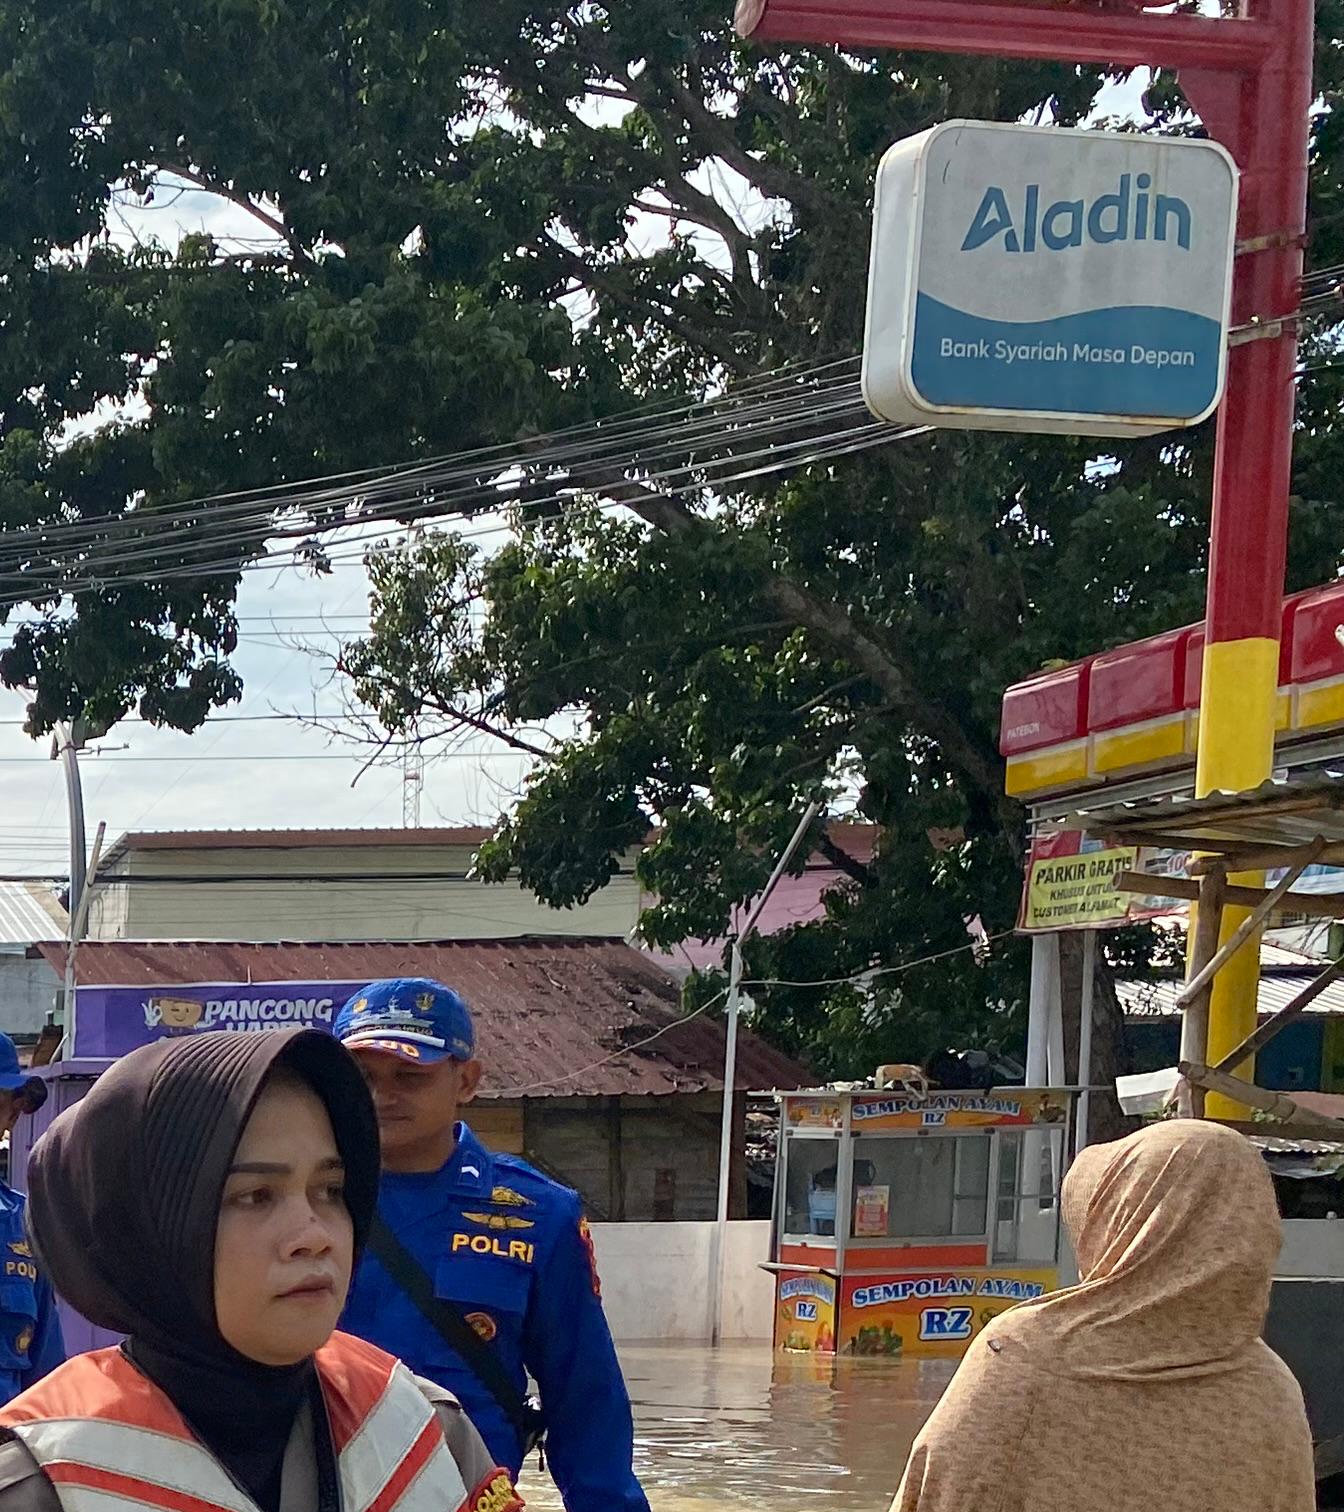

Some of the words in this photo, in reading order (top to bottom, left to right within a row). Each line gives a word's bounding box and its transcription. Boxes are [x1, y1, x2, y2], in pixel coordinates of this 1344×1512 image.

[961, 173, 1191, 252] Aladin
[941, 338, 989, 358] Bank
[995, 339, 1068, 364] Syariah
[1073, 343, 1125, 363] Masa
[1131, 346, 1195, 369] Depan
[1035, 863, 1086, 885] PARKIR
[1089, 855, 1133, 878] GRATIS
[205, 998, 333, 1025] PANCONG
[923, 1112, 946, 1125] RZ
[962, 1096, 1021, 1116] AYAM
[452, 1233, 535, 1264] POLRI
[854, 1278, 976, 1306] SEMPOLAN
[977, 1278, 1044, 1300] AYAM
[797, 1302, 817, 1319] RZ
[923, 1309, 972, 1337] RZ
